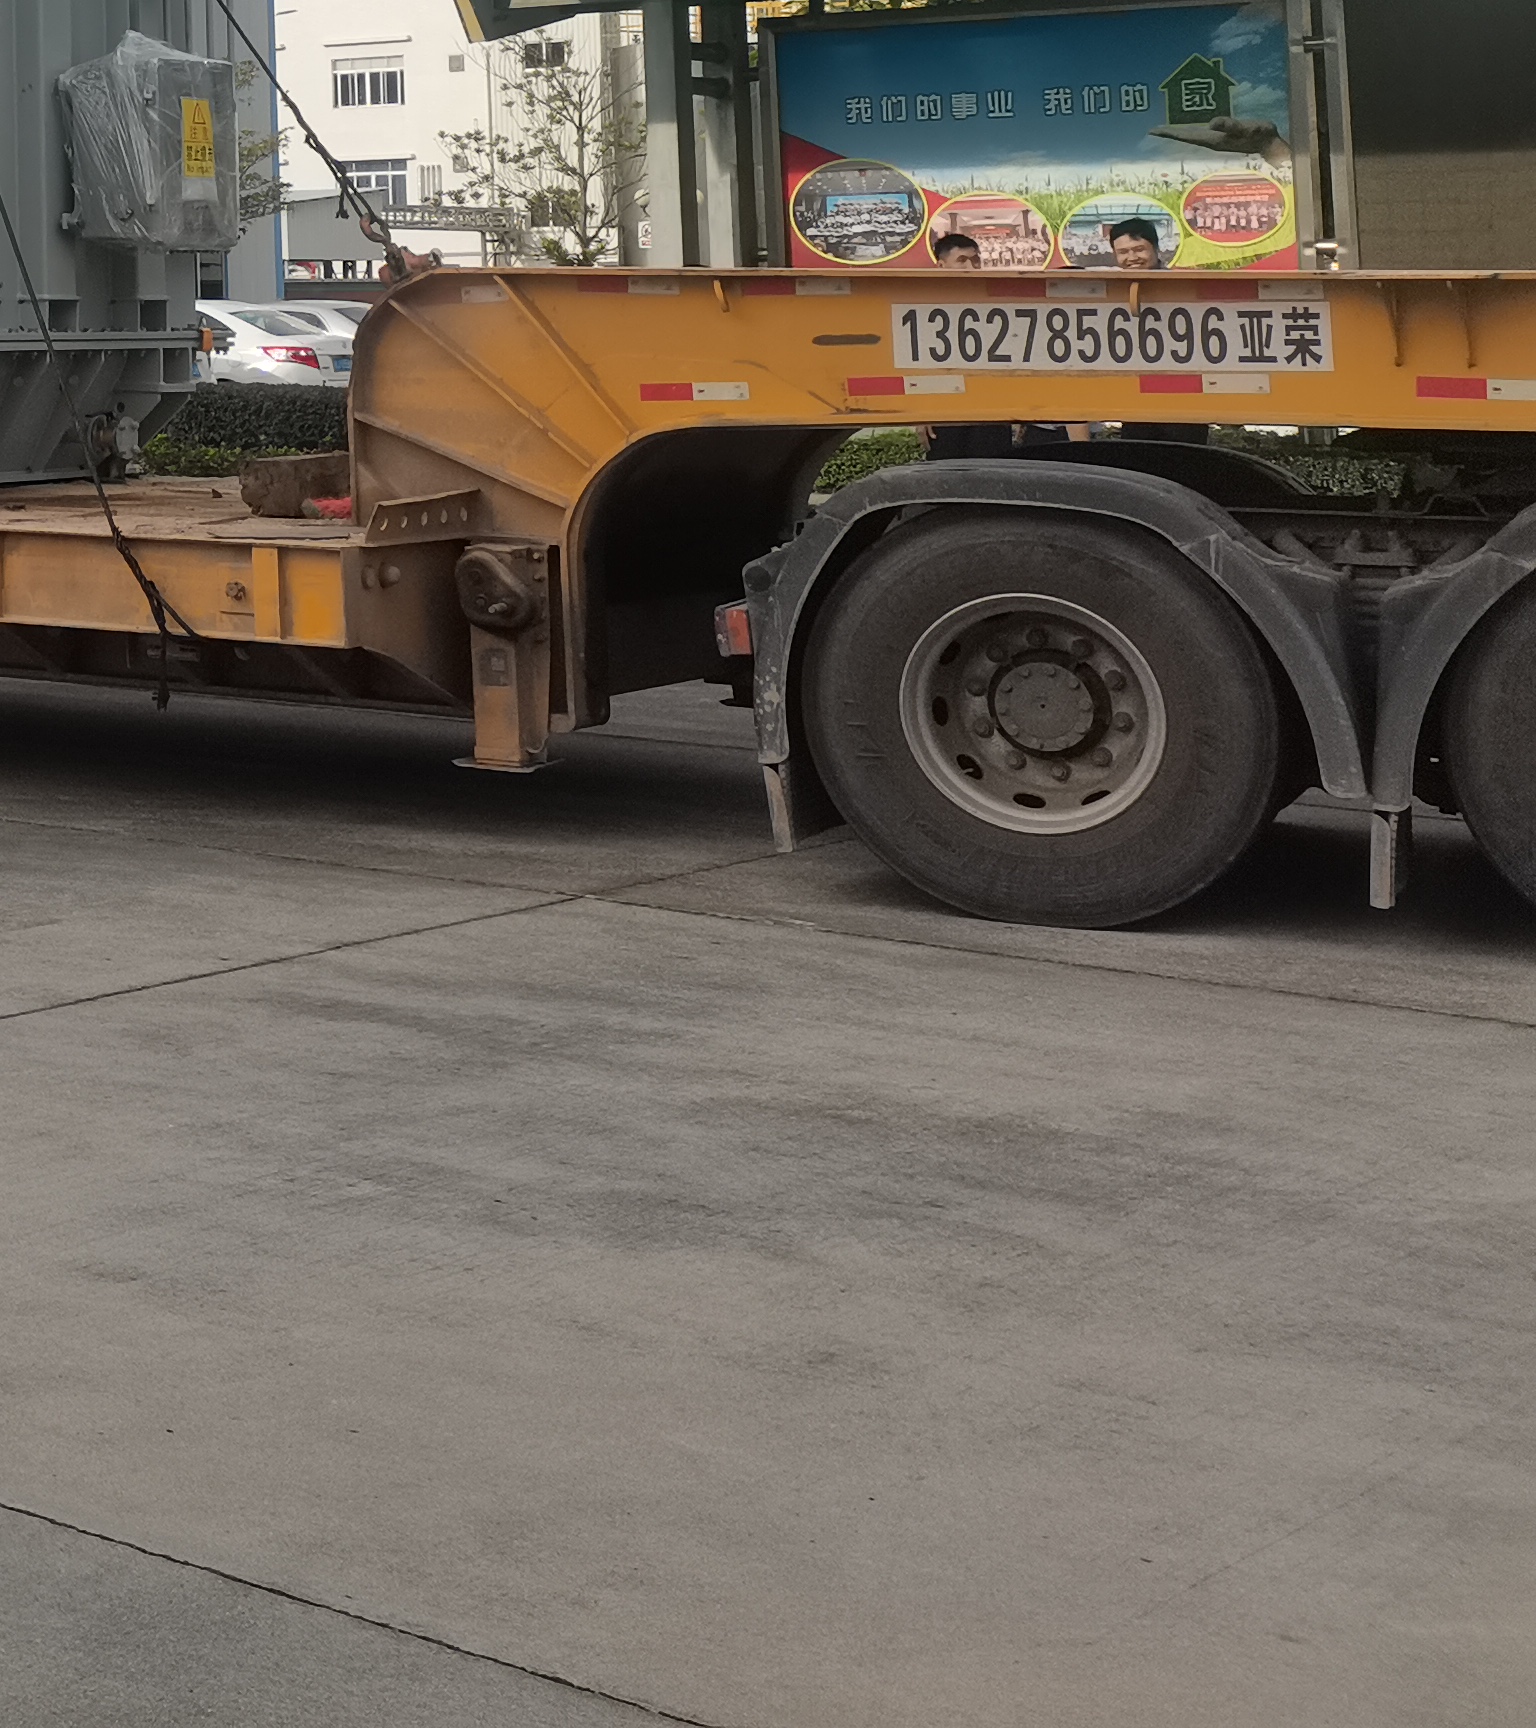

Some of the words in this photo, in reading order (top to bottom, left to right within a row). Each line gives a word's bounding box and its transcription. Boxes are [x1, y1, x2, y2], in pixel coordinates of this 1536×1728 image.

[845, 89, 1016, 124] 我们的事业
